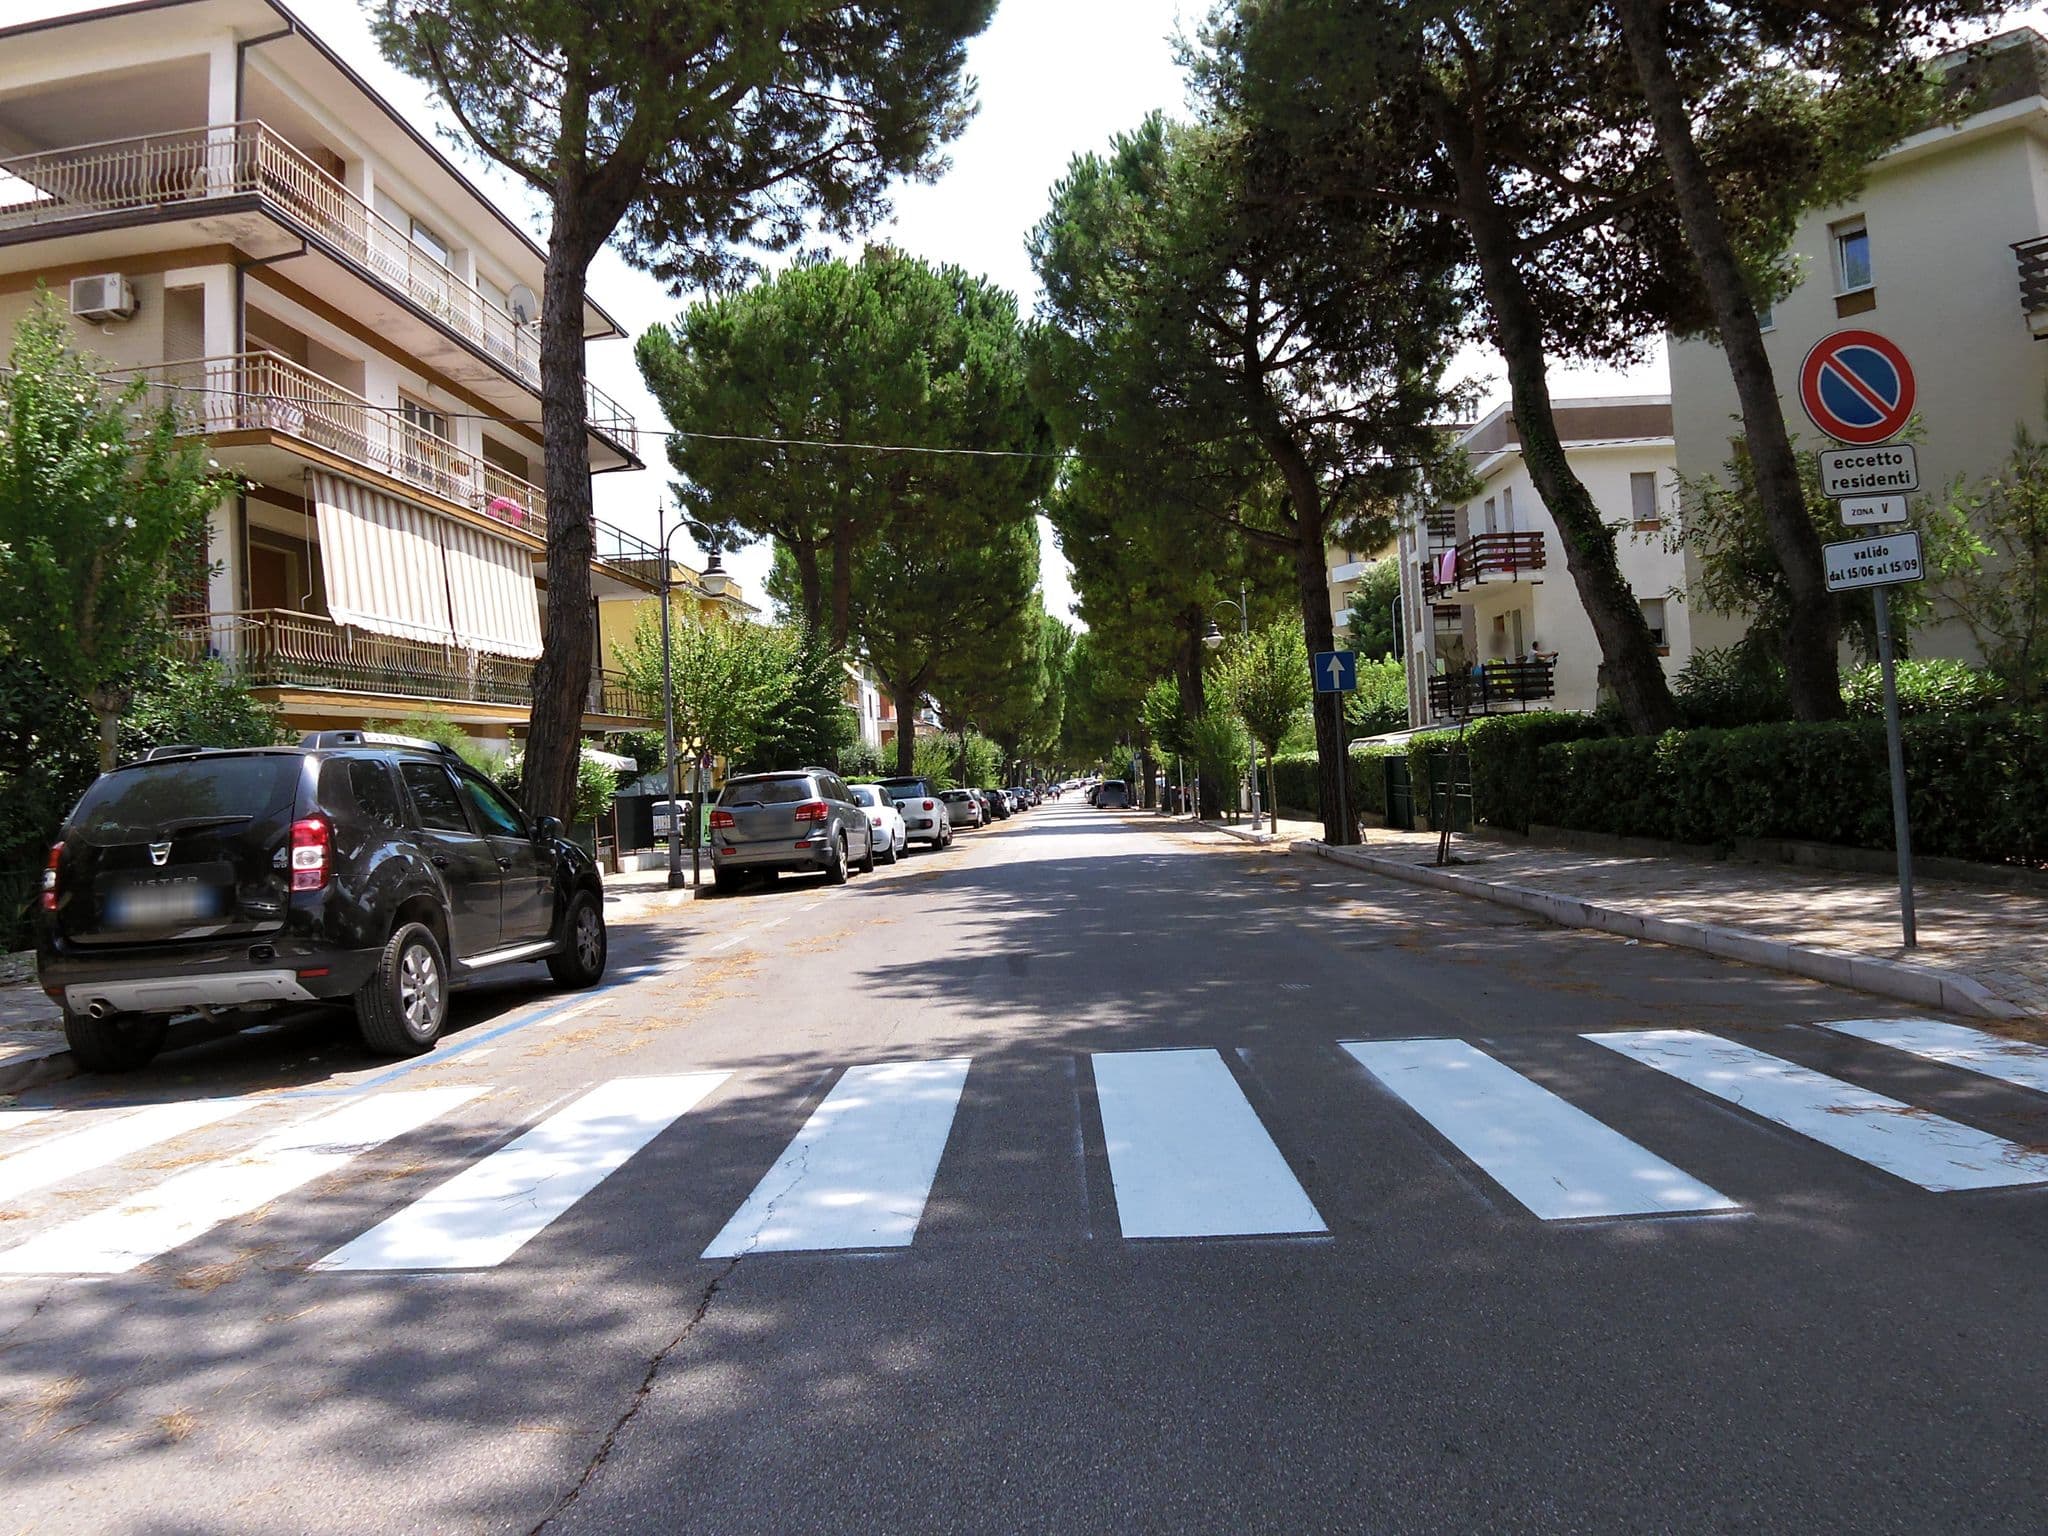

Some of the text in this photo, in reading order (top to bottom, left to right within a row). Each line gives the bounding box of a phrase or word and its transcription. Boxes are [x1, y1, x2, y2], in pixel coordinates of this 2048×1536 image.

[1834, 452, 1903, 469] eccetto
[1832, 470, 1911, 490] residenti
[1851, 503, 1889, 516] ZONA V
[1854, 545, 1889, 560] valido
[1829, 559, 1918, 582] dal 15/06 al 15/09
[273, 847, 288, 861] 4
